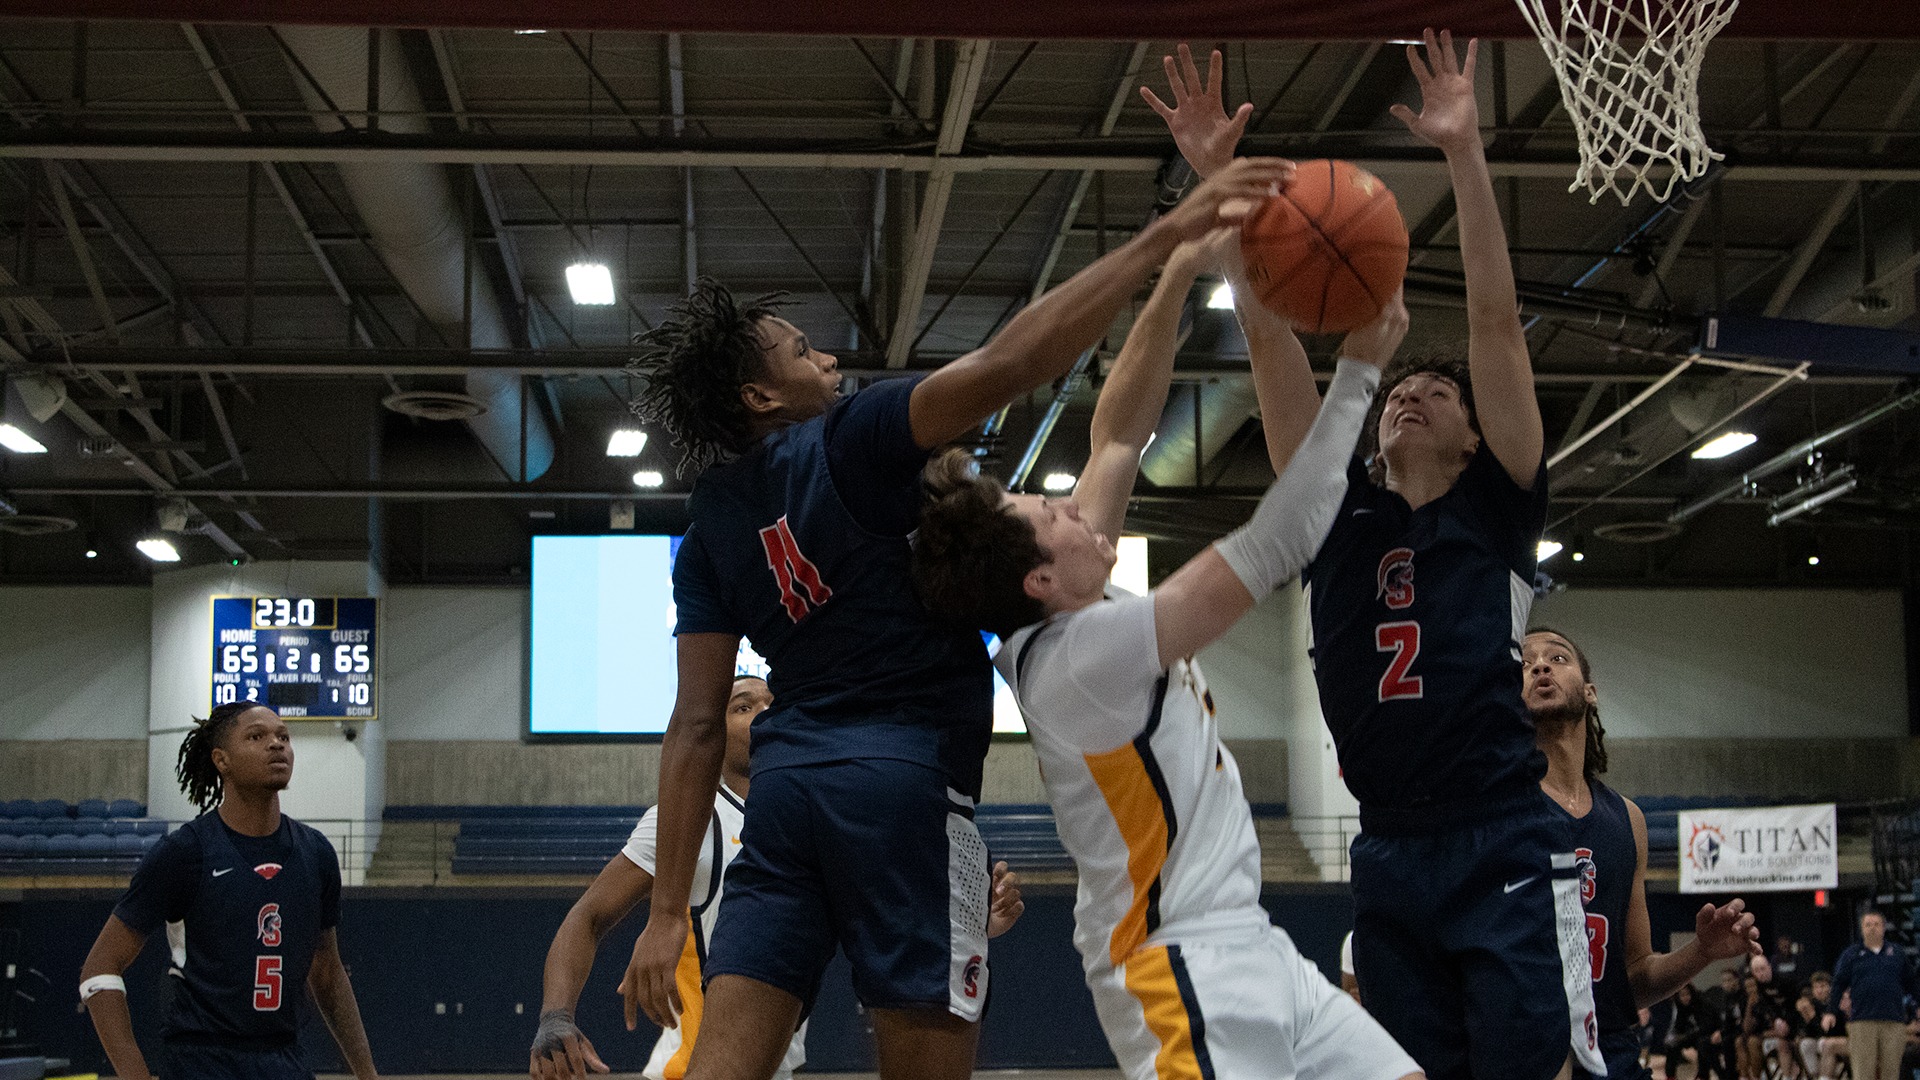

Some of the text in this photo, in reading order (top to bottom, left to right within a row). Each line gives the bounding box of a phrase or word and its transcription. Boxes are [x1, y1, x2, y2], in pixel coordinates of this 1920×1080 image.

[758, 512, 834, 624] 11
[255, 598, 315, 627] 23.0
[220, 629, 257, 643] HOME
[279, 636, 310, 646] PERIOD
[330, 629, 370, 643] GUEST
[223, 645, 258, 673] 65
[286, 648, 300, 670] 2
[334, 645, 370, 673] 65
[1375, 619, 1423, 703] 2
[213, 673, 241, 683] FOULS
[268, 673, 323, 683] PLAYER FOUL
[346, 673, 373, 683] FOULS
[216, 683, 237, 704] 10
[348, 683, 369, 705] 10
[278, 707, 373, 717] MATCH SCORE
[1734, 824, 1831, 854] TITAN
[1738, 854, 1832, 868] RISK SOLUTIONS
[253, 954, 283, 1012] 5
